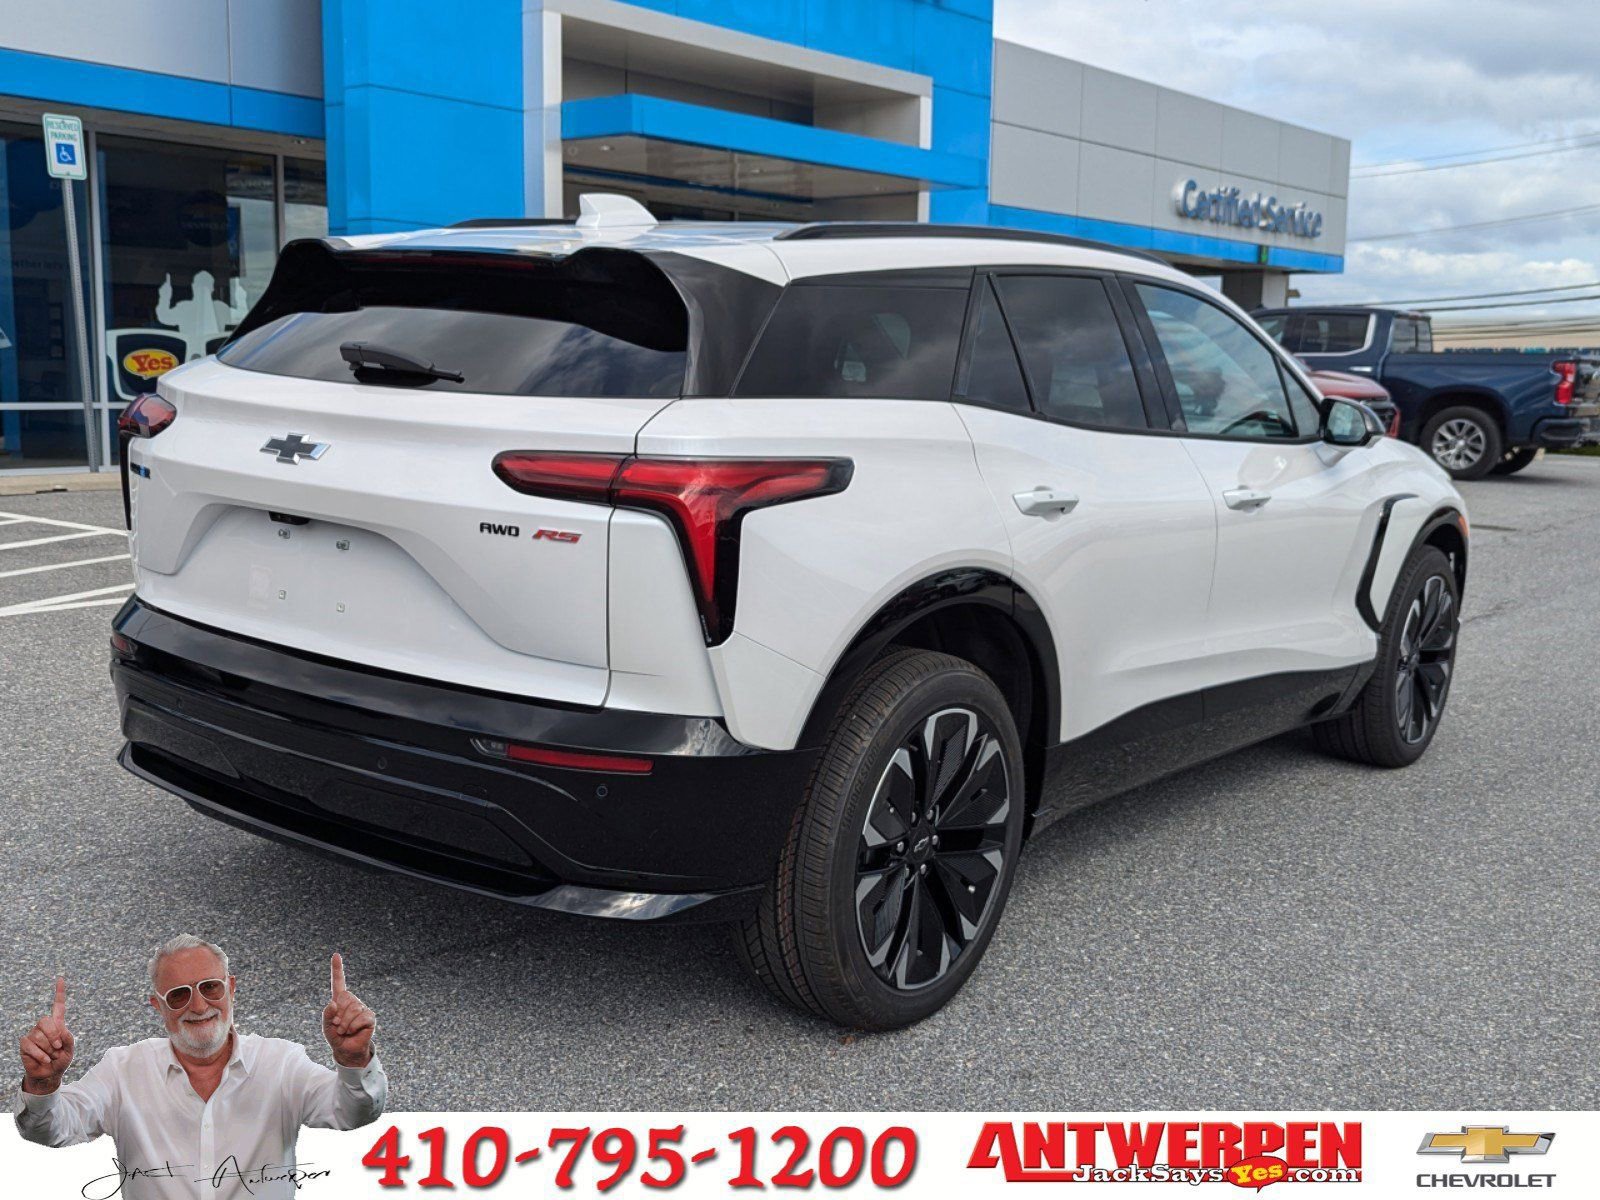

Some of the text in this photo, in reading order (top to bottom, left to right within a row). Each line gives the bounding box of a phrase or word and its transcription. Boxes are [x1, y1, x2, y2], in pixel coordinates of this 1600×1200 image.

[50, 130, 78, 141] PARKING
[1173, 179, 1322, 238] Certified Service
[133, 352, 176, 374] Yes
[532, 529, 582, 544] RS
